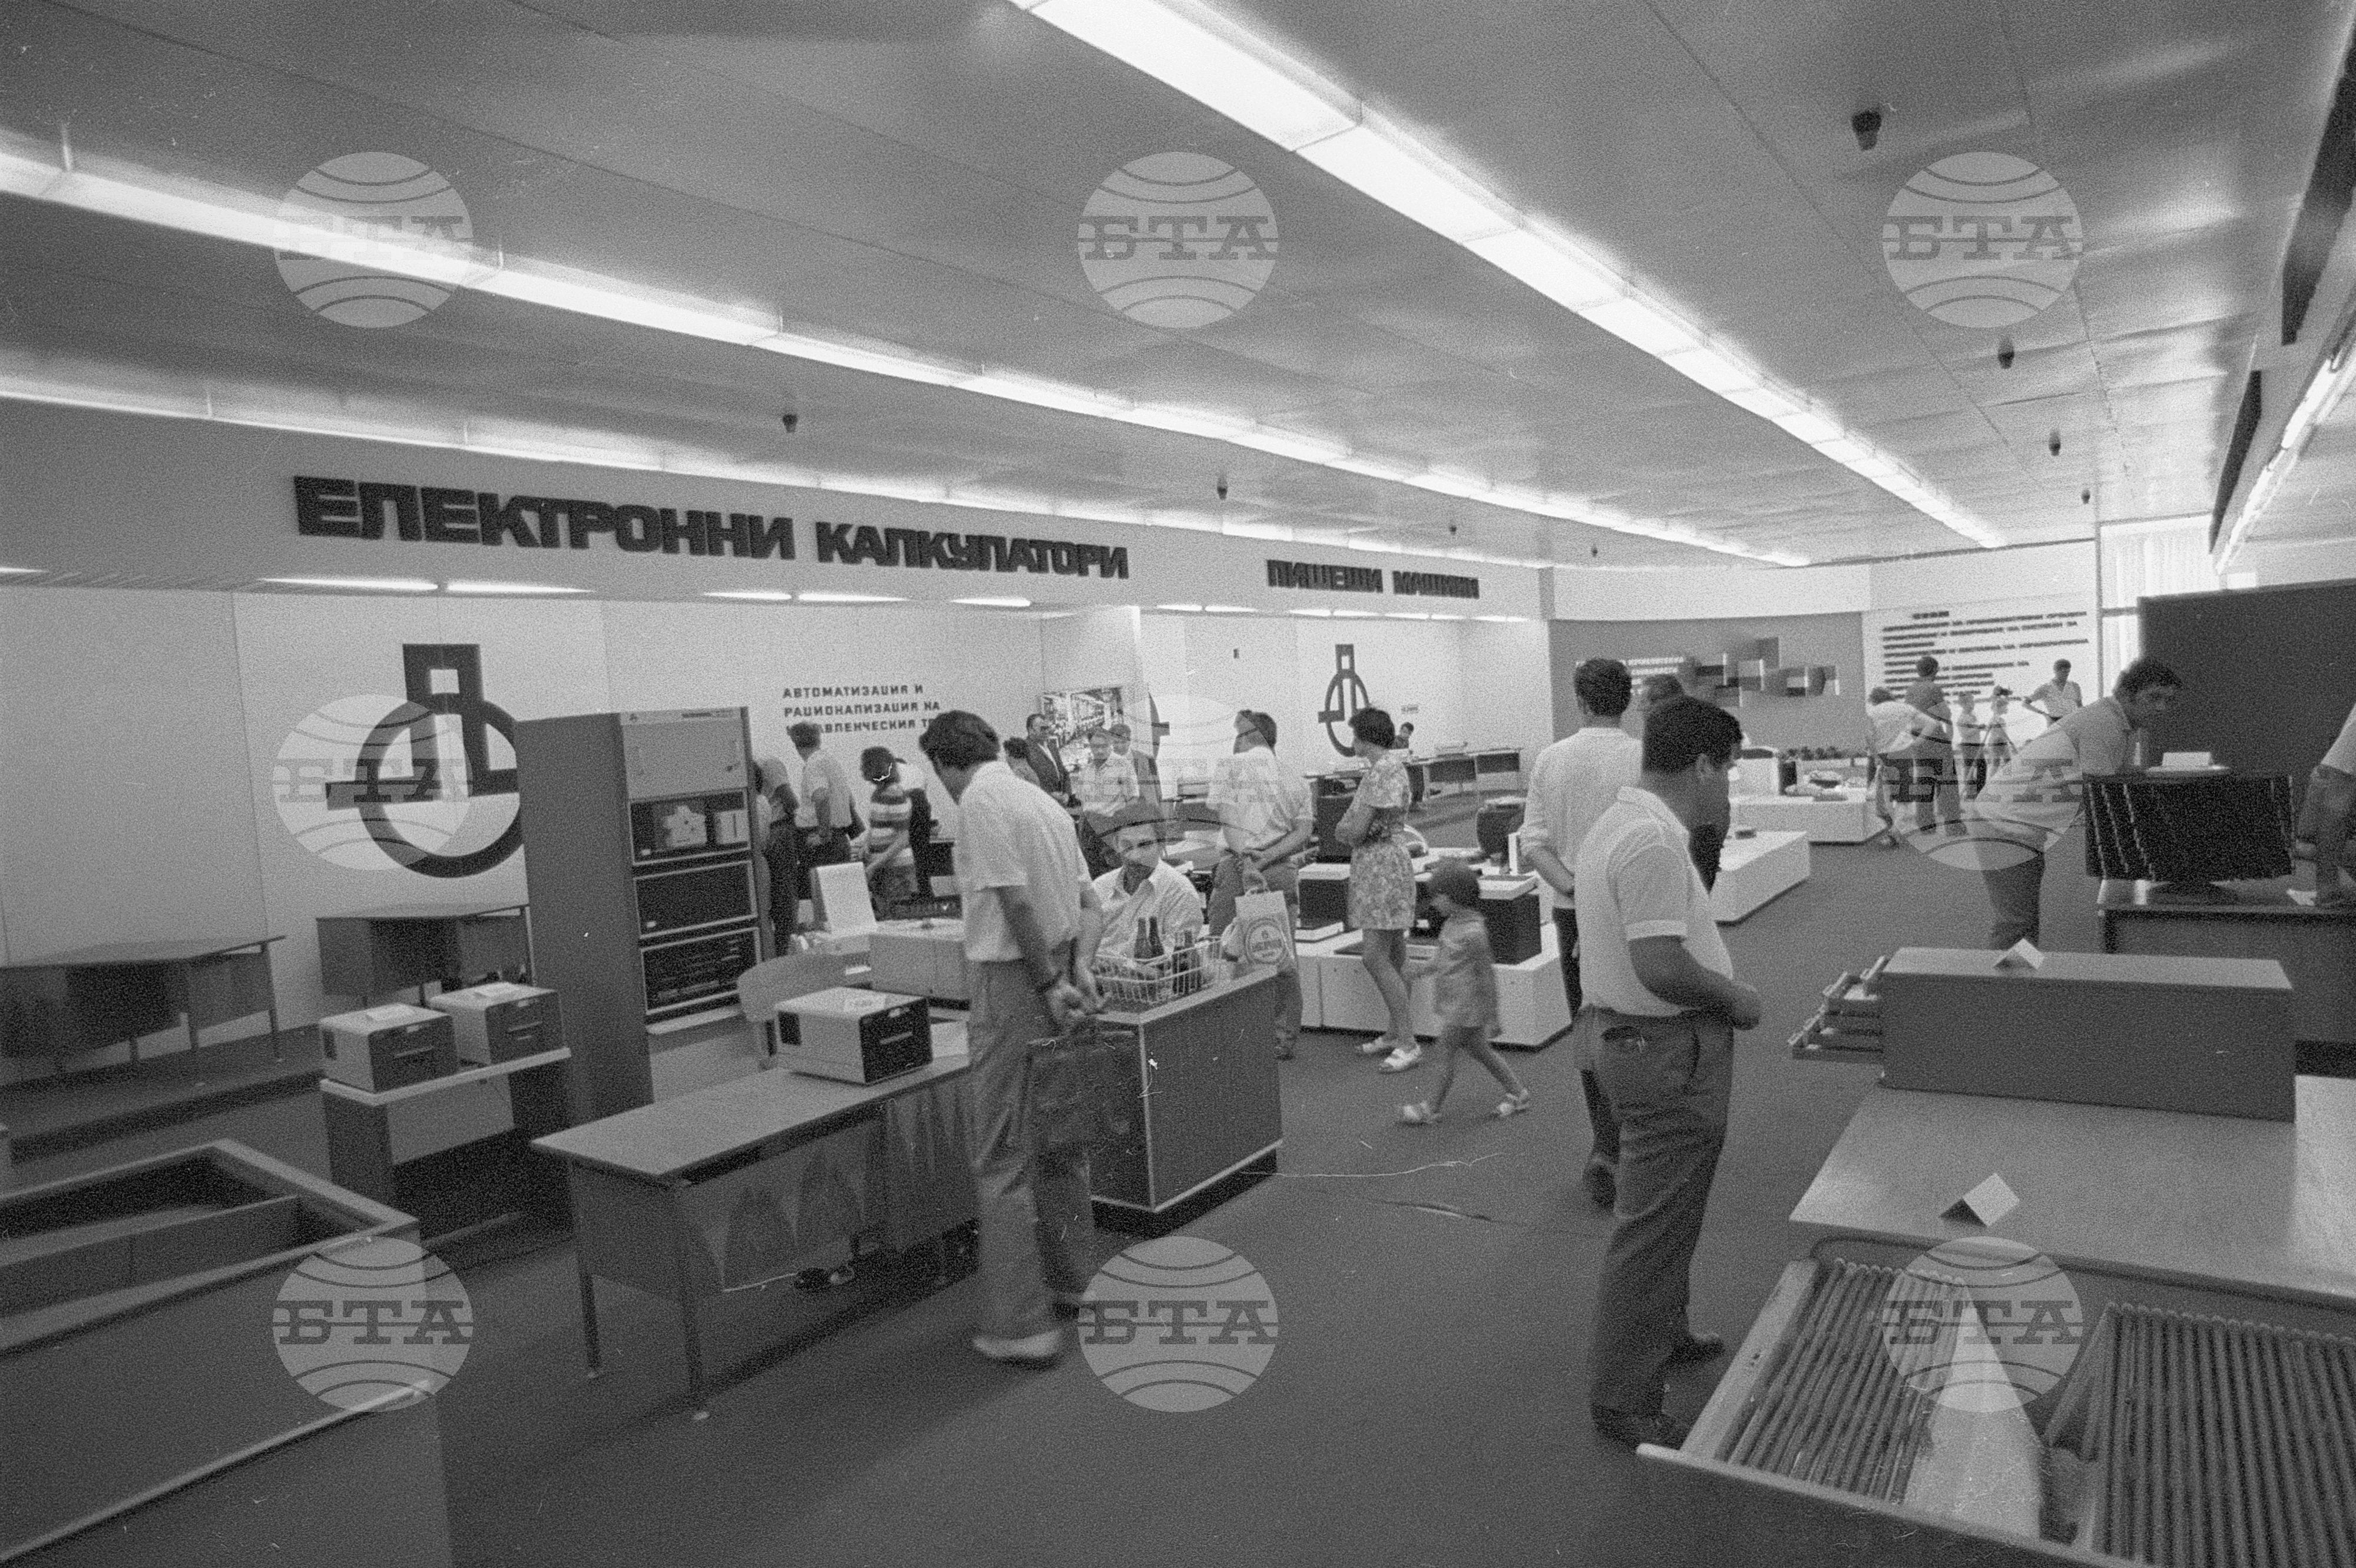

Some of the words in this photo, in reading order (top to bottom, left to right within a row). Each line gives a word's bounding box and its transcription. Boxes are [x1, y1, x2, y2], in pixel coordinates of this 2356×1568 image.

[782, 684, 908, 699] АВТОМАТИЗАЦИЯ
[915, 684, 924, 694] И
[784, 702, 918, 717] РАЦИОНАЛИЗАЦИЯ
[924, 700, 940, 711] НА
